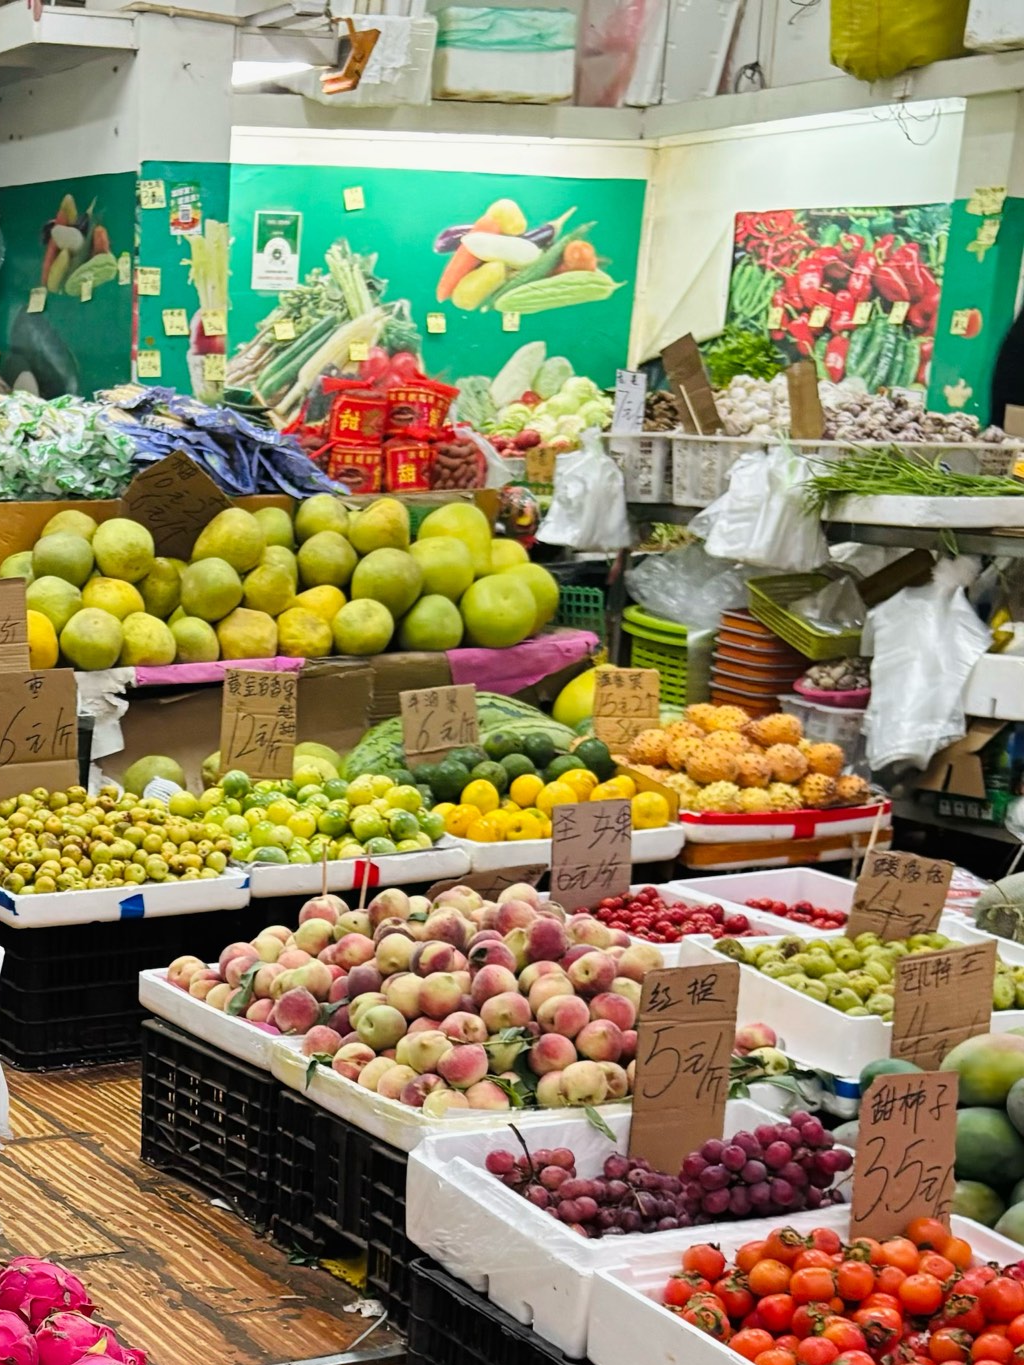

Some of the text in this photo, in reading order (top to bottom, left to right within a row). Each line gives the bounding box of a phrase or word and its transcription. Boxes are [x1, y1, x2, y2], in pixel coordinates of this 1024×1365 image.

[553, 804, 632, 849] 圣女果
[645, 973, 726, 1013] 红提
[871, 1080, 950, 1134] 甜柿子
